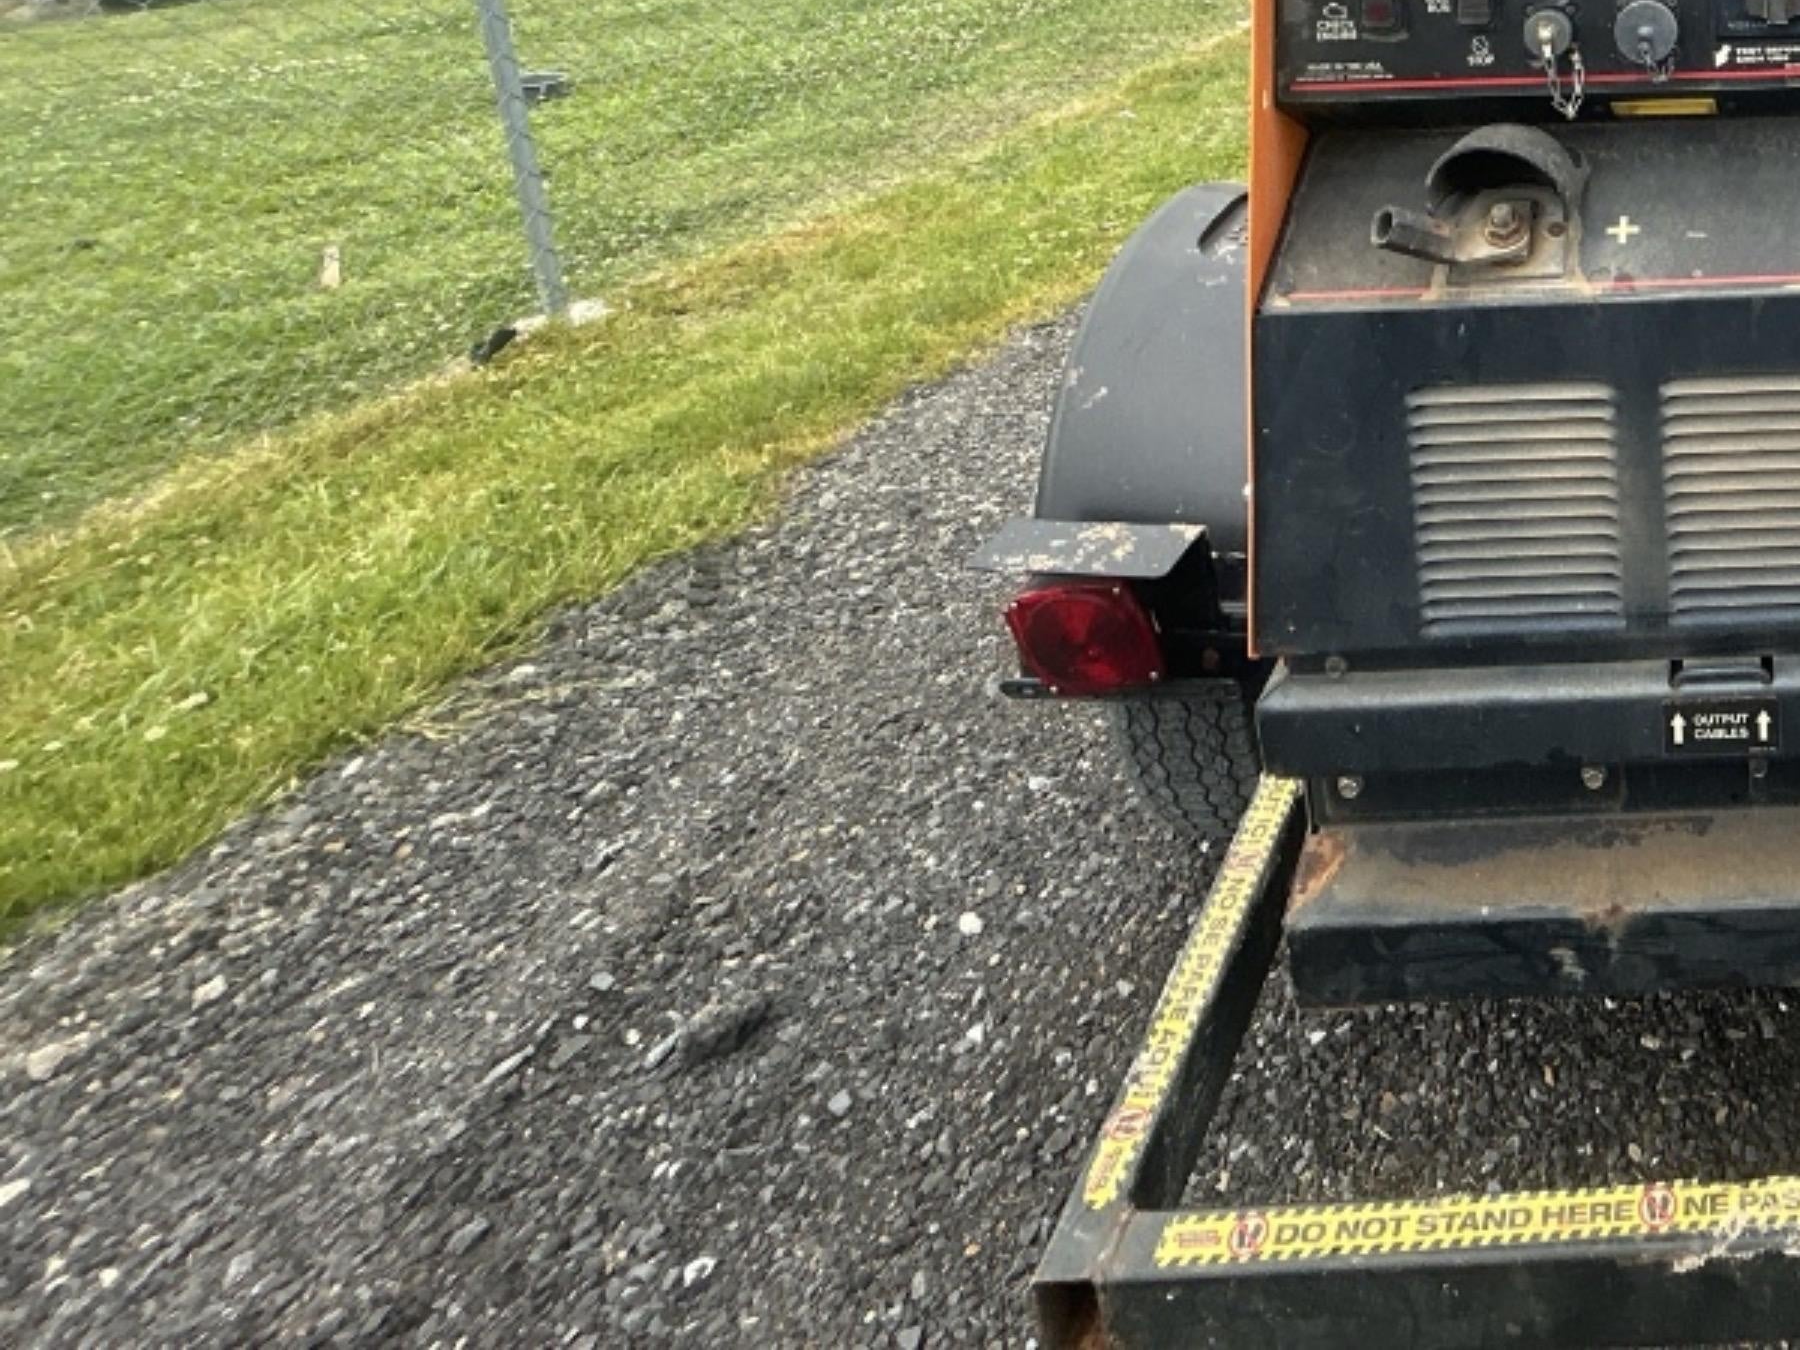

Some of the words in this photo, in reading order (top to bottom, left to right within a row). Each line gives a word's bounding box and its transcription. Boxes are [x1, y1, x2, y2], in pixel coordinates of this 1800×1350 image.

[1693, 713, 1750, 727] OUTPUT
[1694, 727, 1750, 740] CABLES
[1682, 1194, 1731, 1216] NE
[1273, 1221, 1324, 1246] DO
[1334, 1214, 1404, 1242] NOT
[1414, 1206, 1532, 1238] STAND
[1540, 1198, 1637, 1226] HERE
